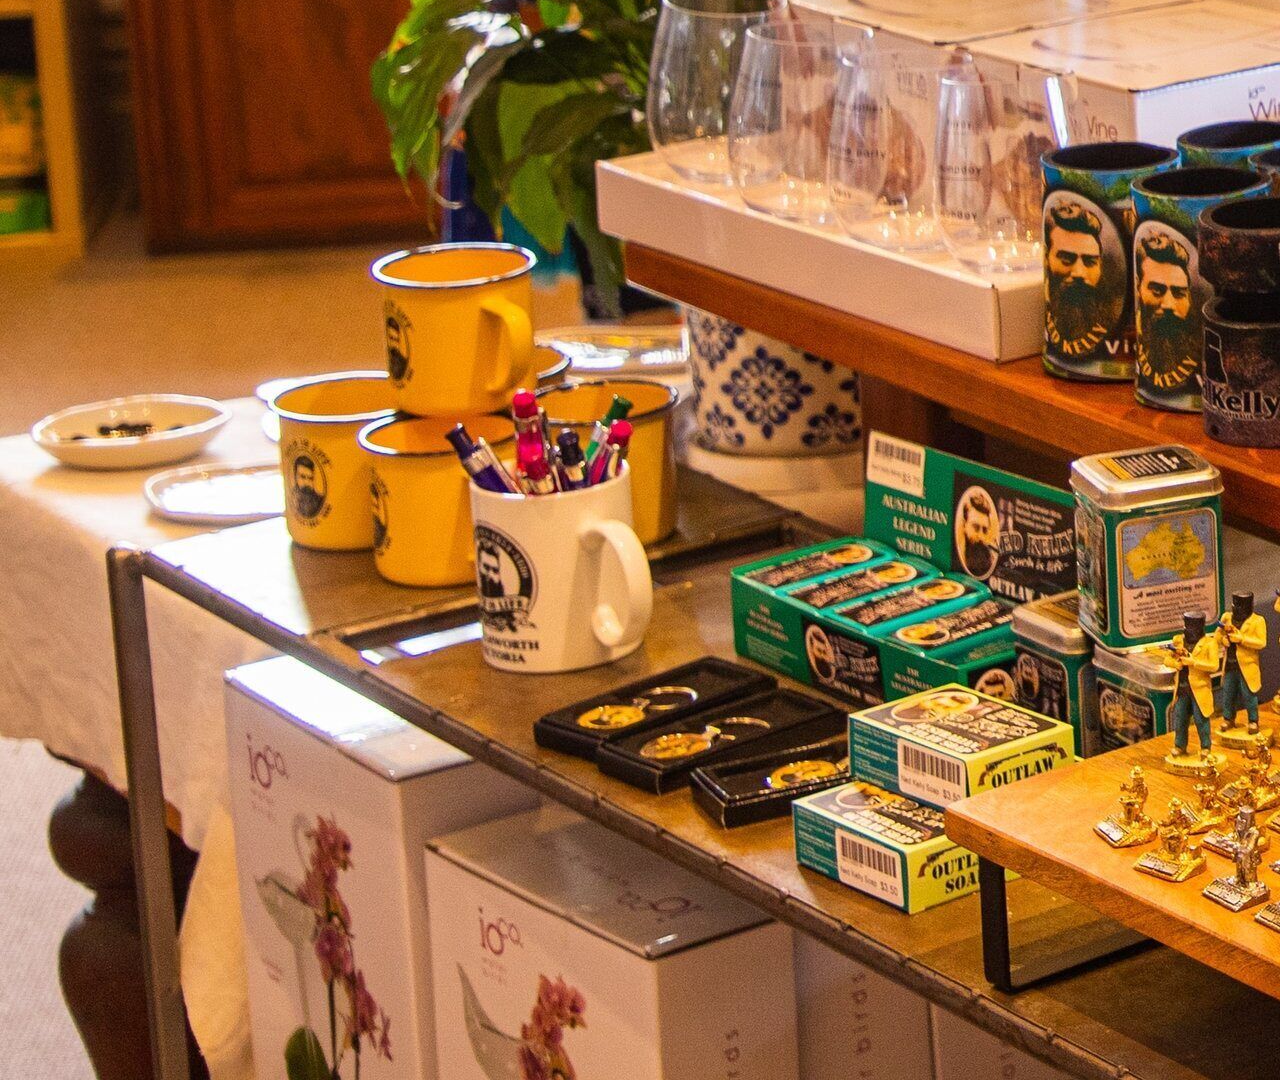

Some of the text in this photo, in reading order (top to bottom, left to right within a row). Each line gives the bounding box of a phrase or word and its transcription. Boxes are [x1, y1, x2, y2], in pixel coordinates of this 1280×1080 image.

[1062, 322, 1107, 356] KELLY
[1153, 354, 1198, 389] KELLY
[881, 493, 949, 525] AUSTRALIAN
[892, 516, 936, 542] LEGEND
[1026, 528, 1075, 557] KELLY
[896, 536, 933, 560] SERIES
[991, 756, 1056, 790] OUTLAW
[879, 881, 899, 897] $3.50
